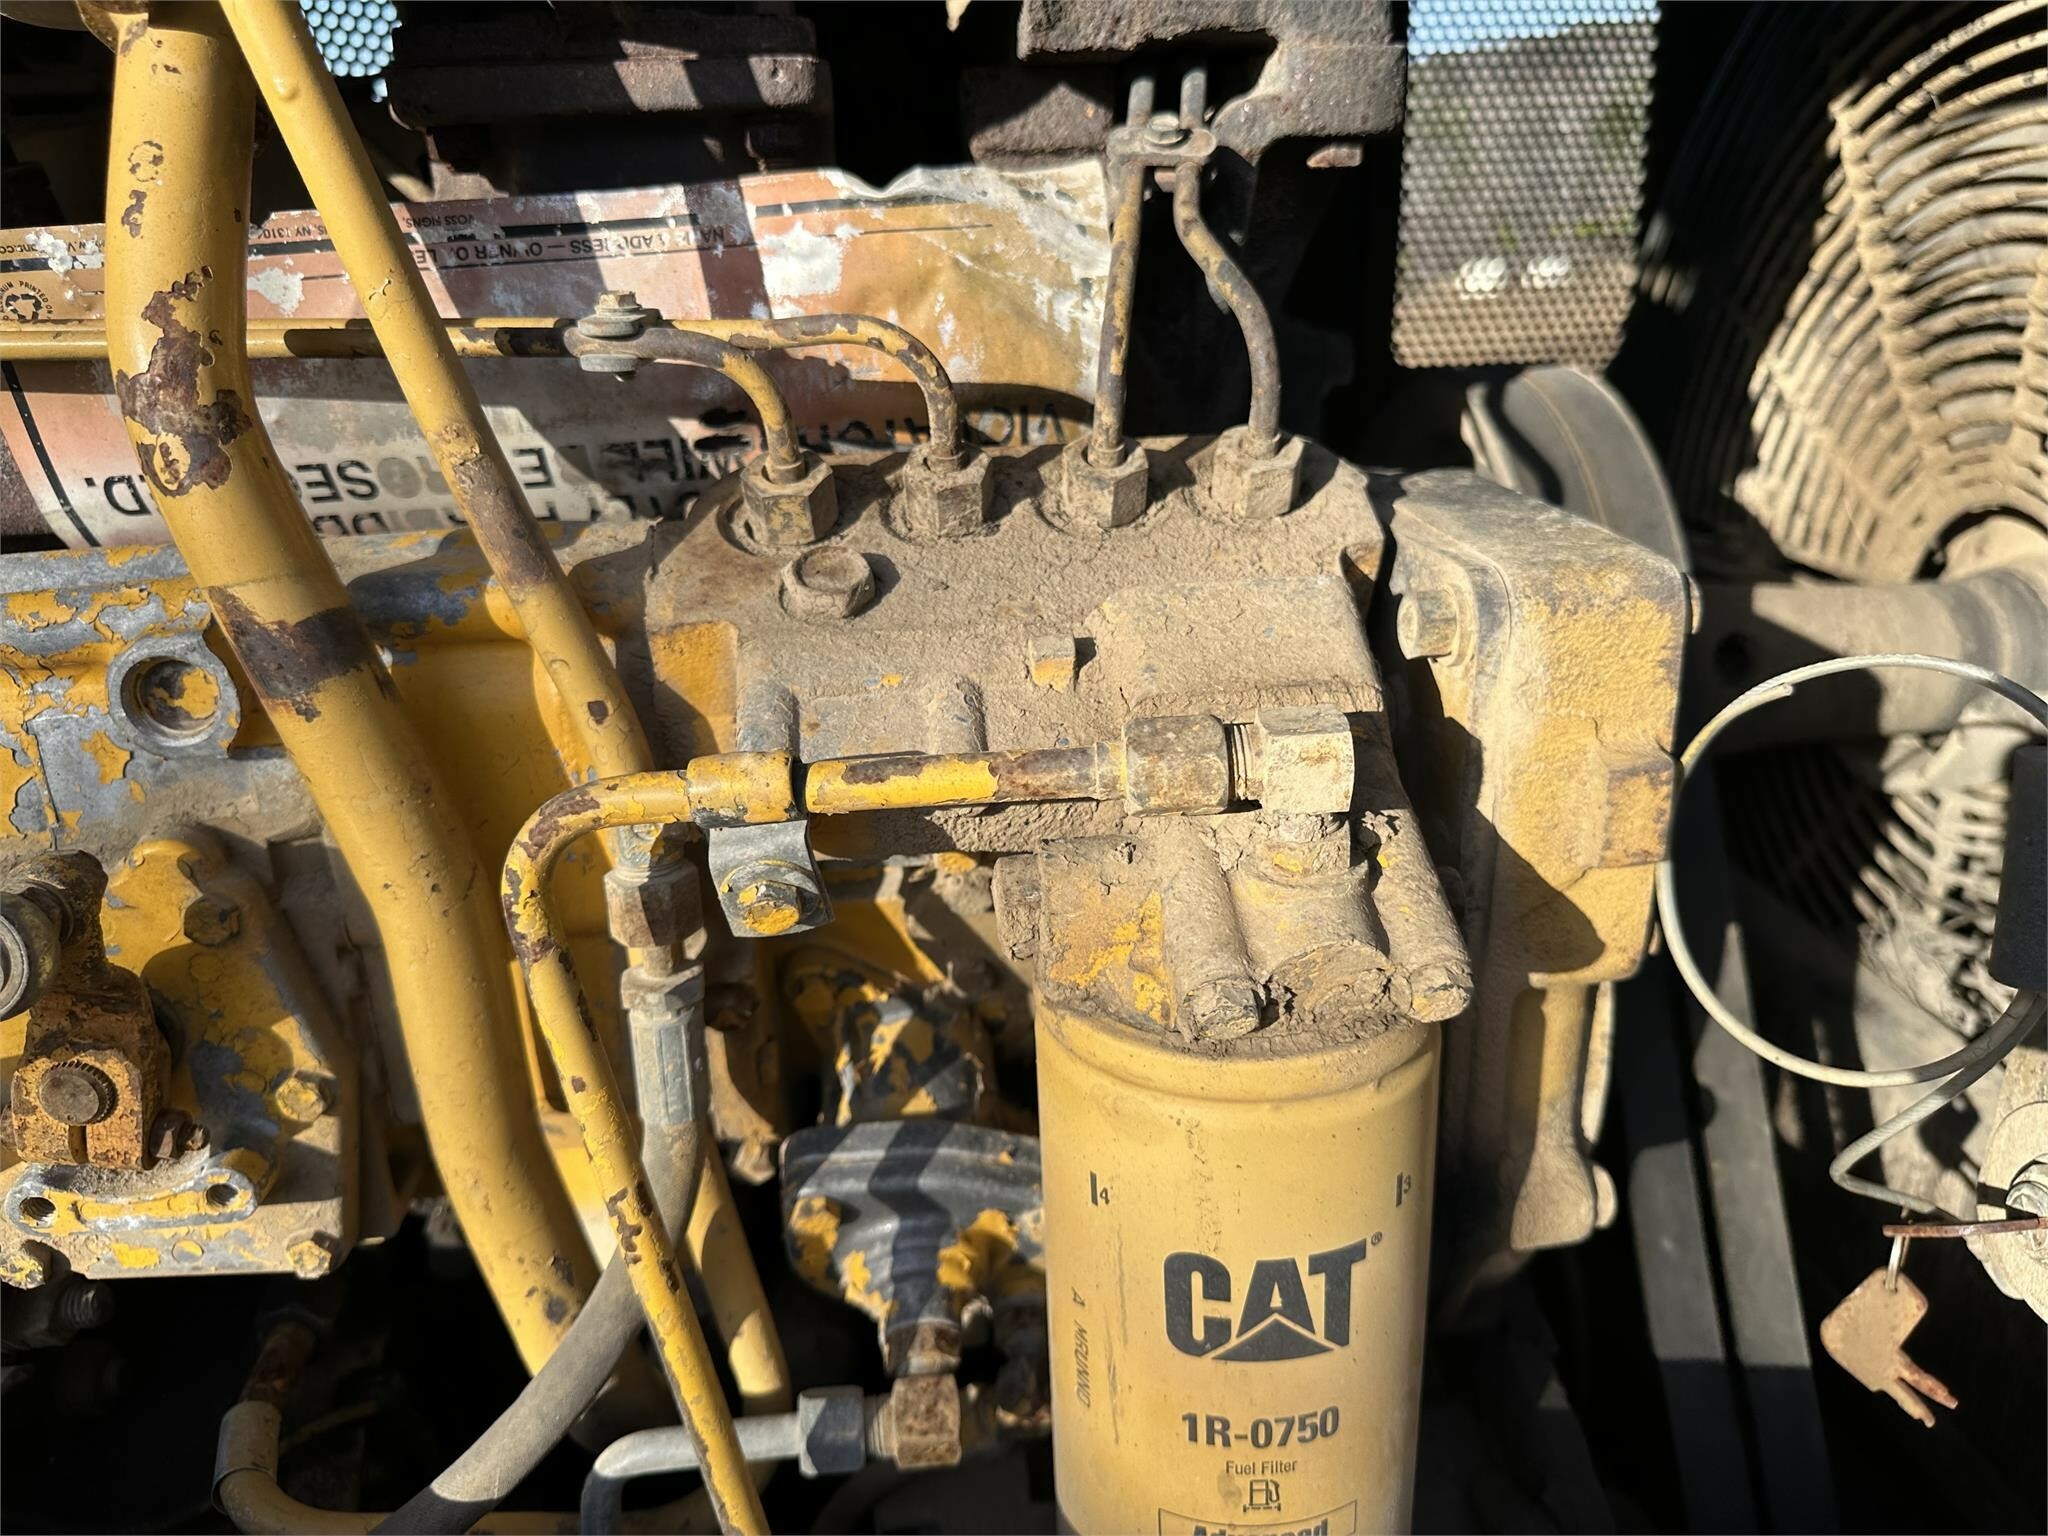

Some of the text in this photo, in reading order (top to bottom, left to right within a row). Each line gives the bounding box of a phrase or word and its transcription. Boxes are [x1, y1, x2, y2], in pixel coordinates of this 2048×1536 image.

[295, 227, 312, 238] NY
[18, 280, 49, 303] PRINTED
[1181, 1406, 1340, 1448] 1R-0750
[1225, 1458, 1298, 1475] Fuel Filter
